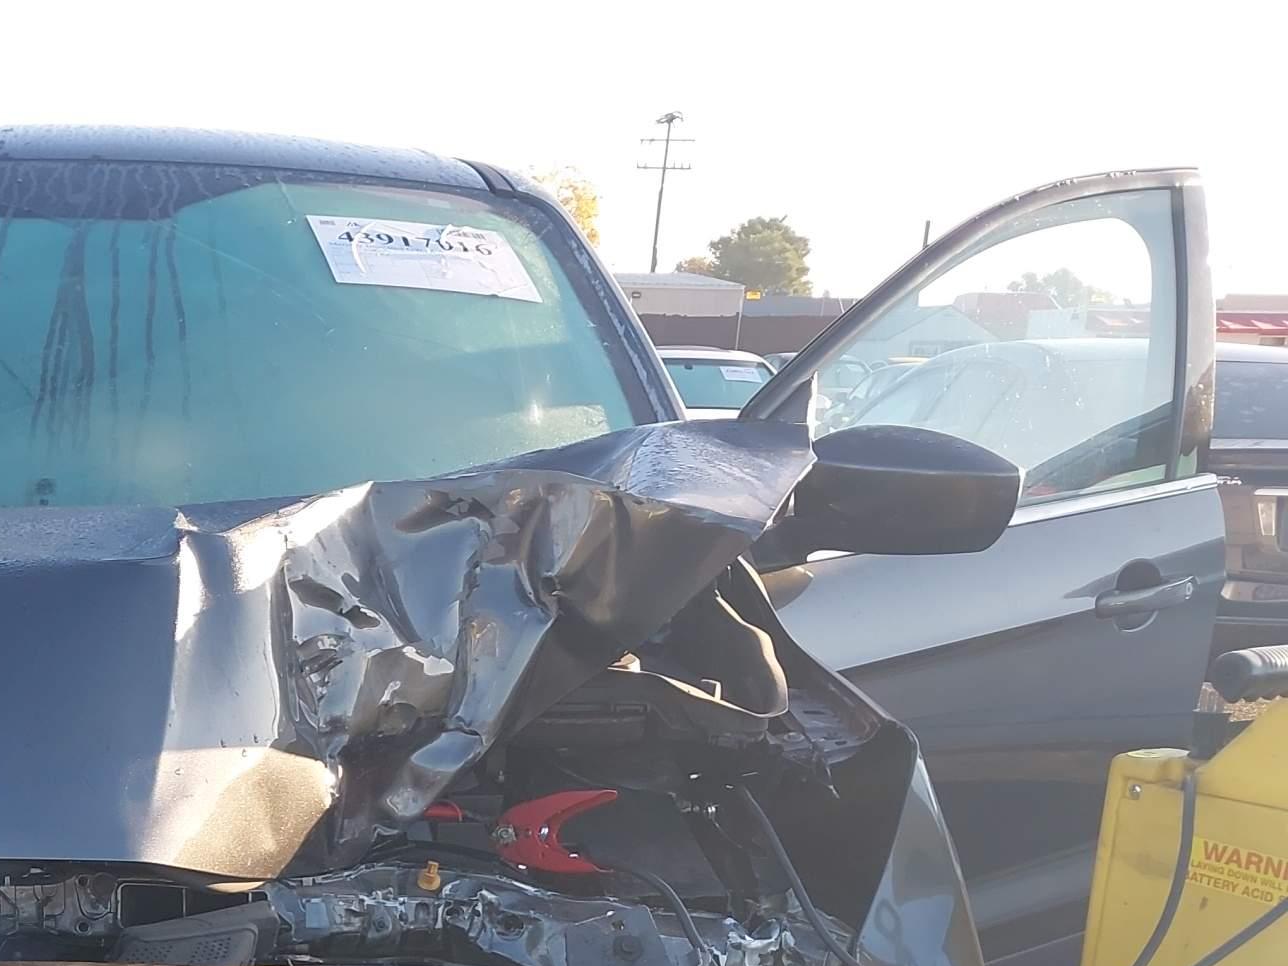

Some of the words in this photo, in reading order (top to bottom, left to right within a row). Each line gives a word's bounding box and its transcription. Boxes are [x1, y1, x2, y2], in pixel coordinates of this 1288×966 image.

[1227, 868, 1258, 884] DOWN
[1260, 877, 1283, 891] WILL
[1241, 886, 1274, 903] ACID
